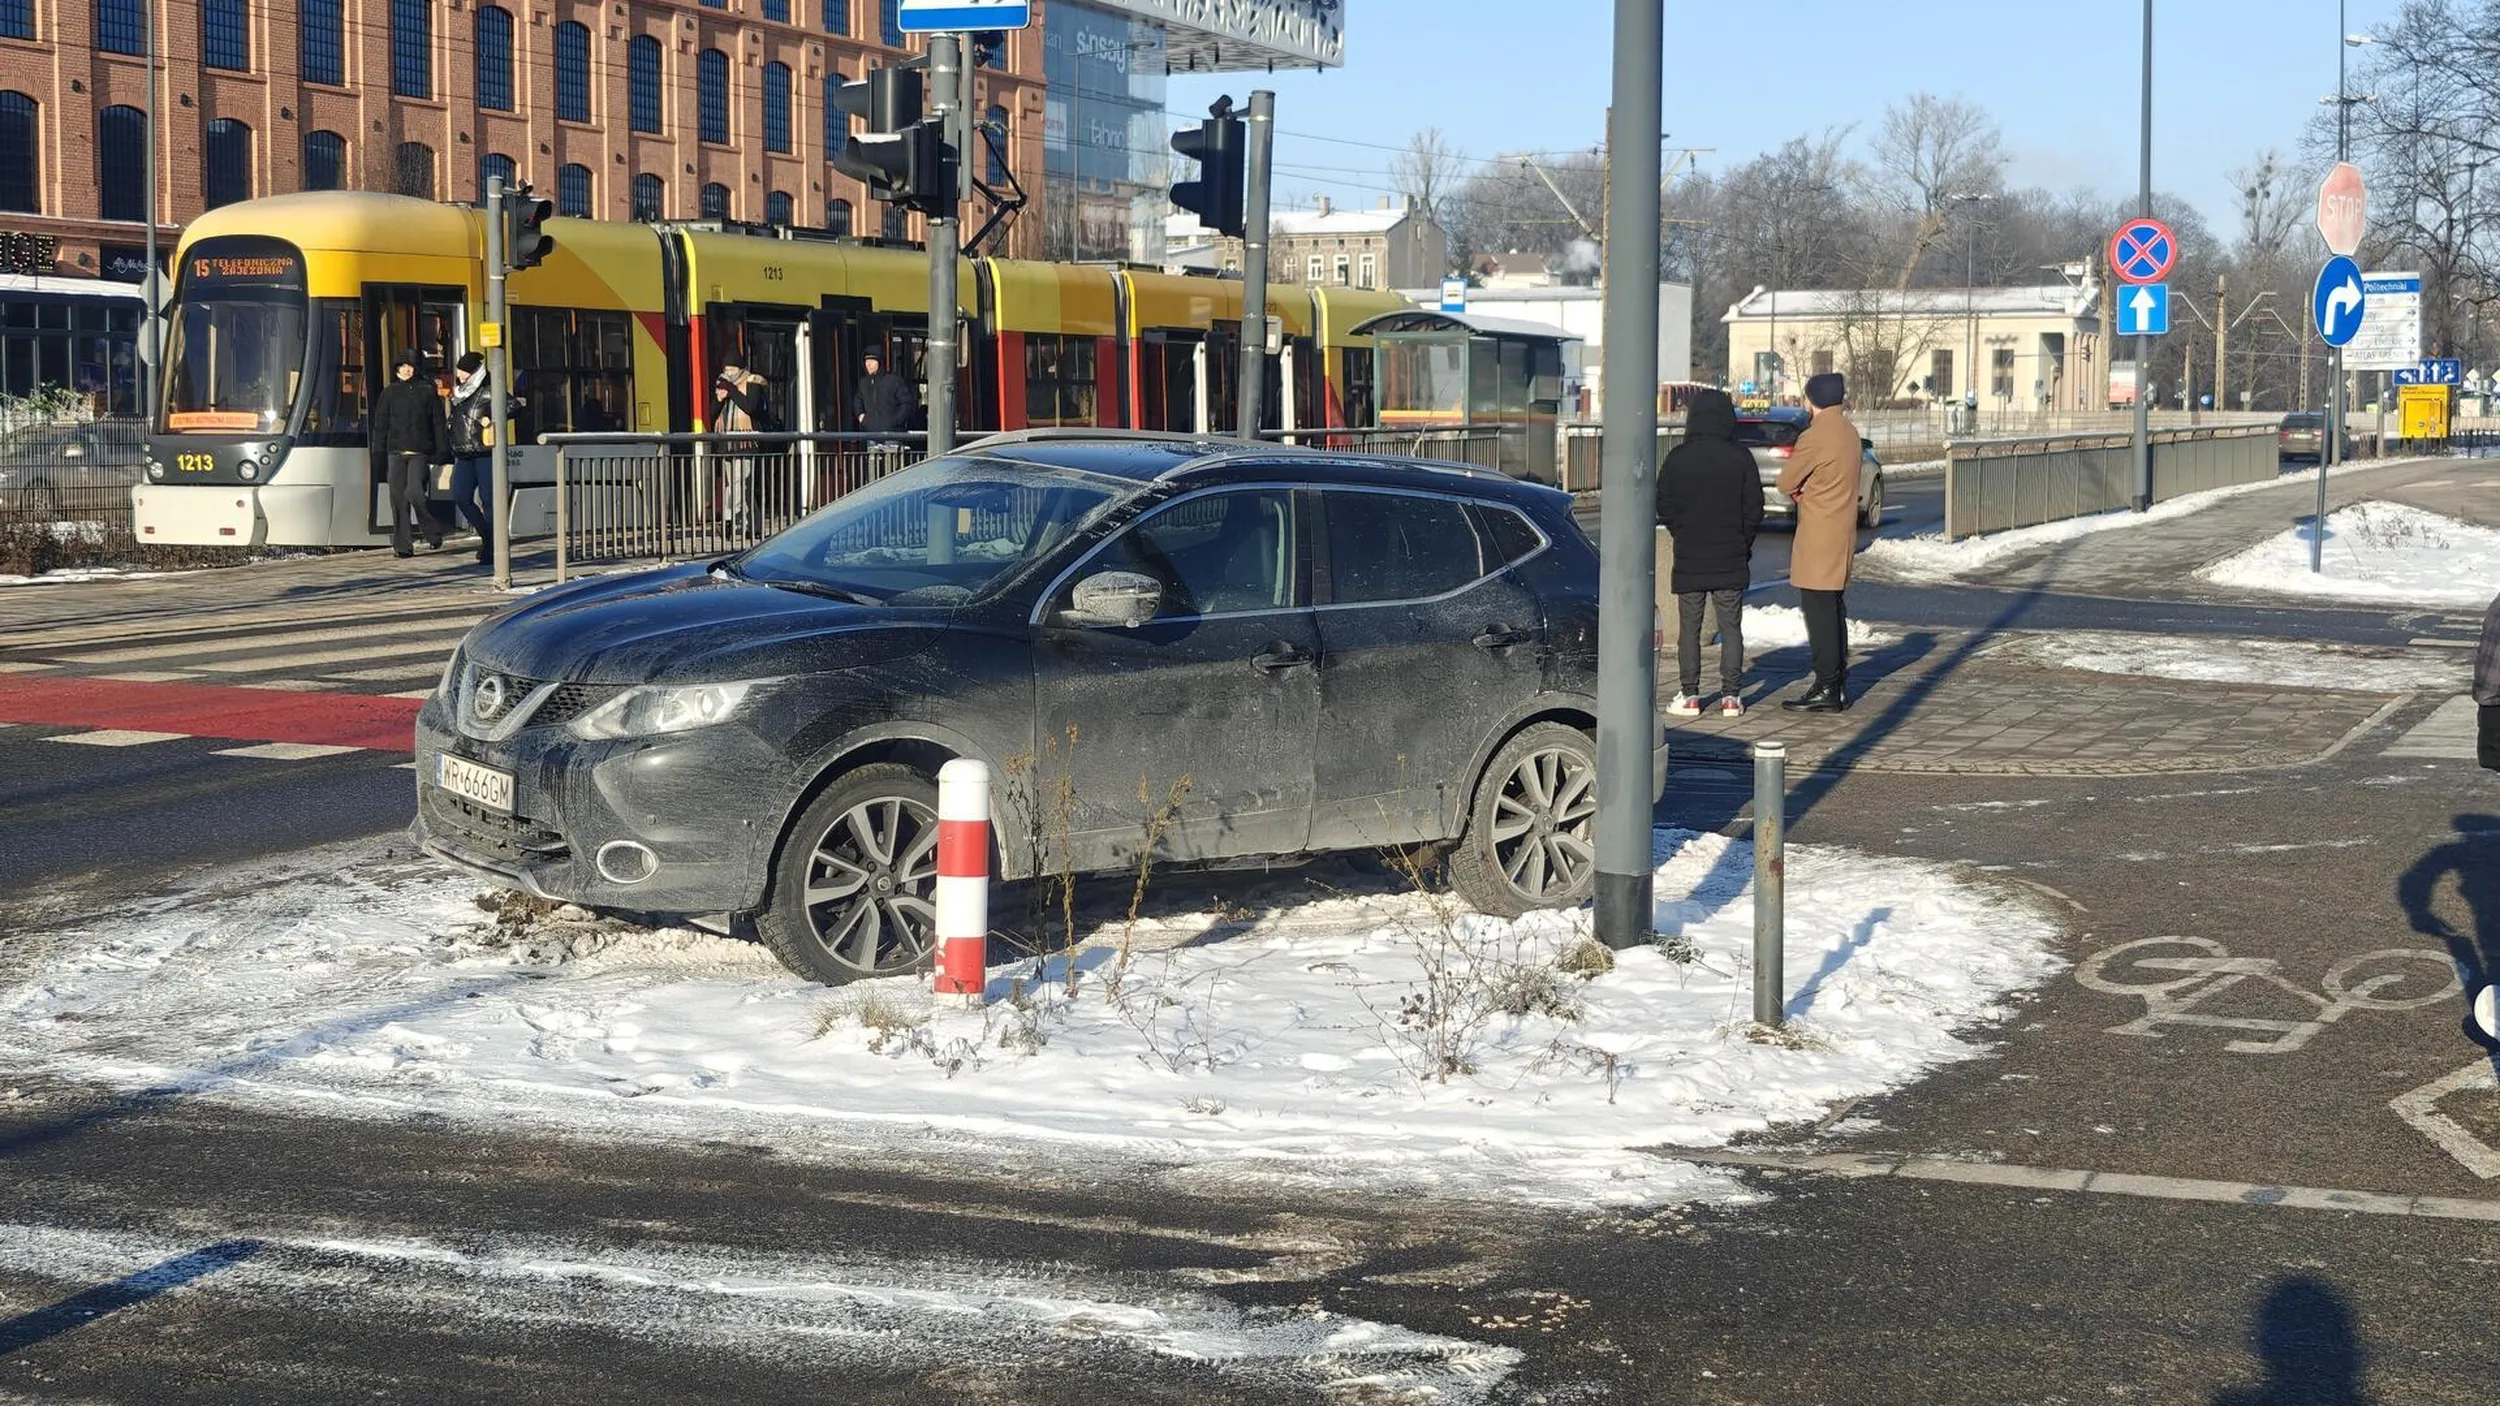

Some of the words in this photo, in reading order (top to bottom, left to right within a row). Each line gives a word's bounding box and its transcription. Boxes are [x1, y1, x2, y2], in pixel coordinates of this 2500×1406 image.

[1076, 25, 1126, 74] sinsay
[2327, 194, 2363, 220] STOP
[194, 258, 210, 277] 15
[763, 266, 783, 281] 1213
[177, 454, 214, 471] 1213
